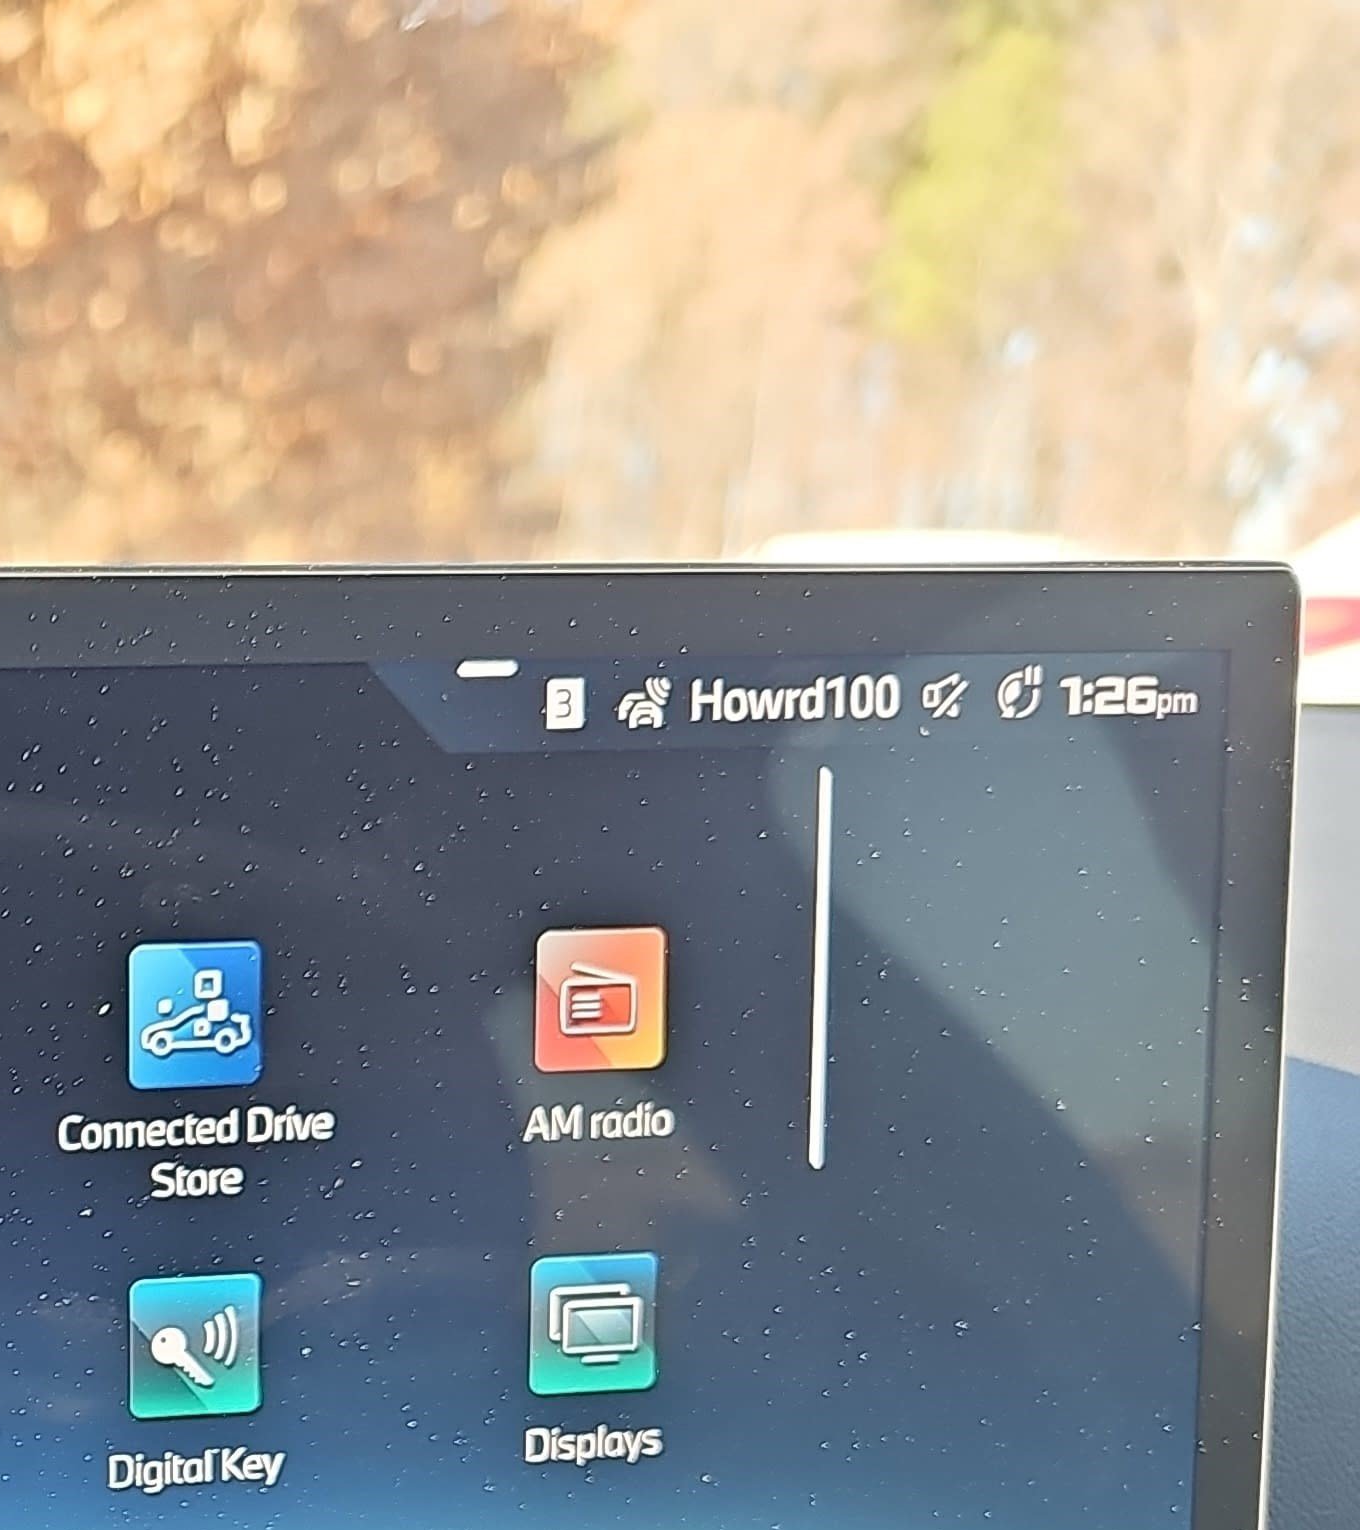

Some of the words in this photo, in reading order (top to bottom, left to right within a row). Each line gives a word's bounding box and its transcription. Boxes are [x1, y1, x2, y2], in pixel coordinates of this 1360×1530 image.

[689, 675, 900, 722] Howrd100
[58, 1108, 239, 1152] Connected
[246, 1106, 336, 1145] Drive
[523, 1106, 584, 1143] AM
[589, 1101, 676, 1139] radio
[150, 1163, 245, 1198] Store
[524, 1425, 663, 1467] Displays
[107, 1450, 215, 1494] Digital
[215, 1448, 286, 1486] Key
